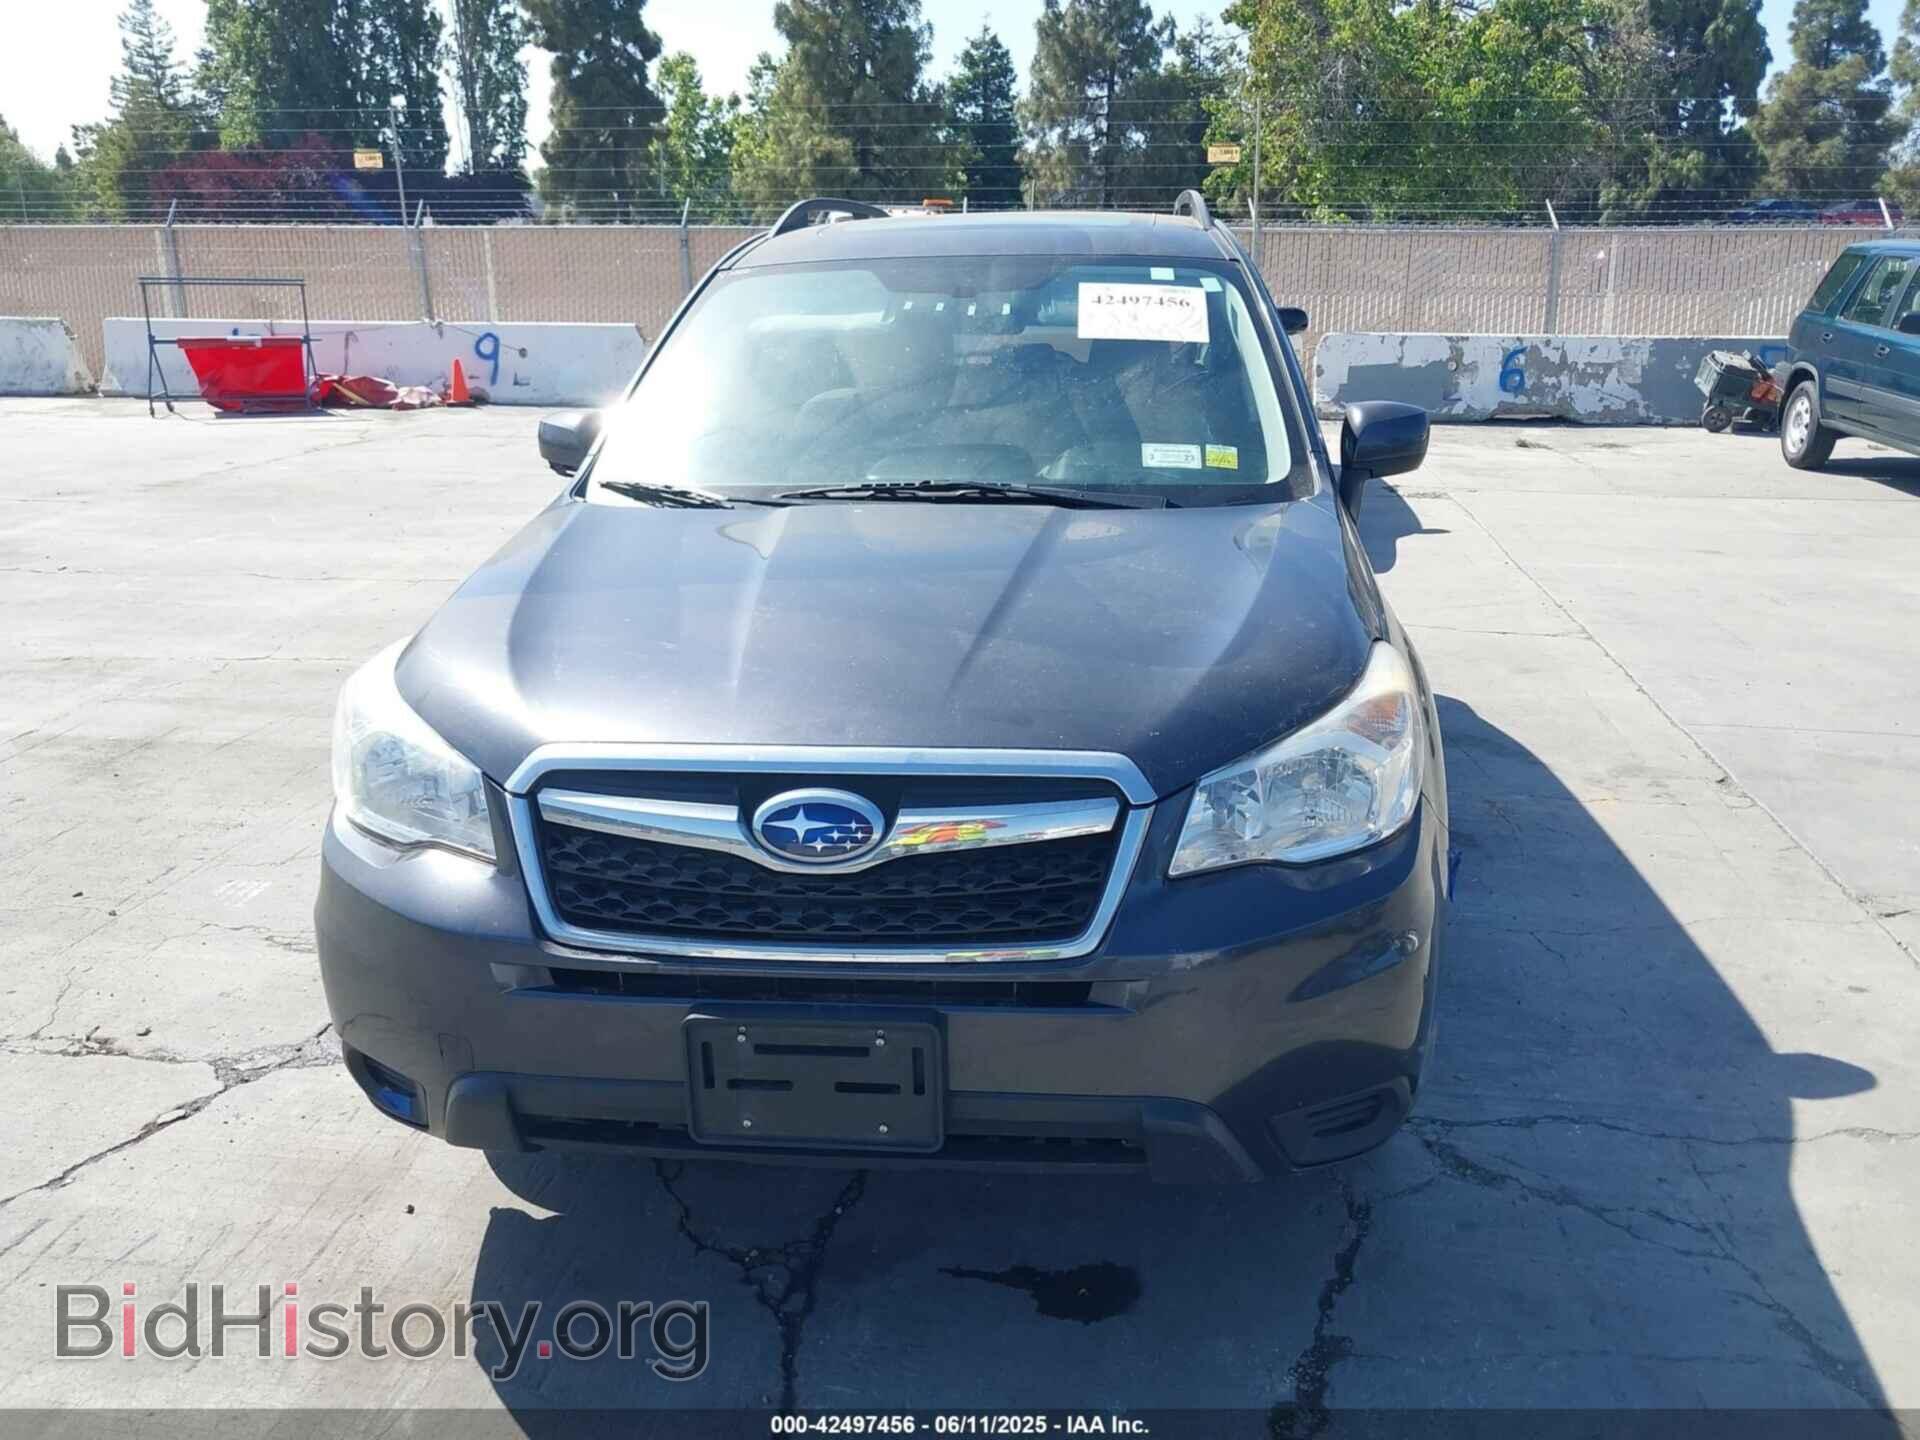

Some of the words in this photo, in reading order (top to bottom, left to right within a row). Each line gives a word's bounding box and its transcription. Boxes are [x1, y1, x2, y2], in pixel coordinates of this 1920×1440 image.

[1091, 294, 1191, 308] 42497456
[475, 332, 501, 387] 9
[1499, 345, 1529, 392] 6
